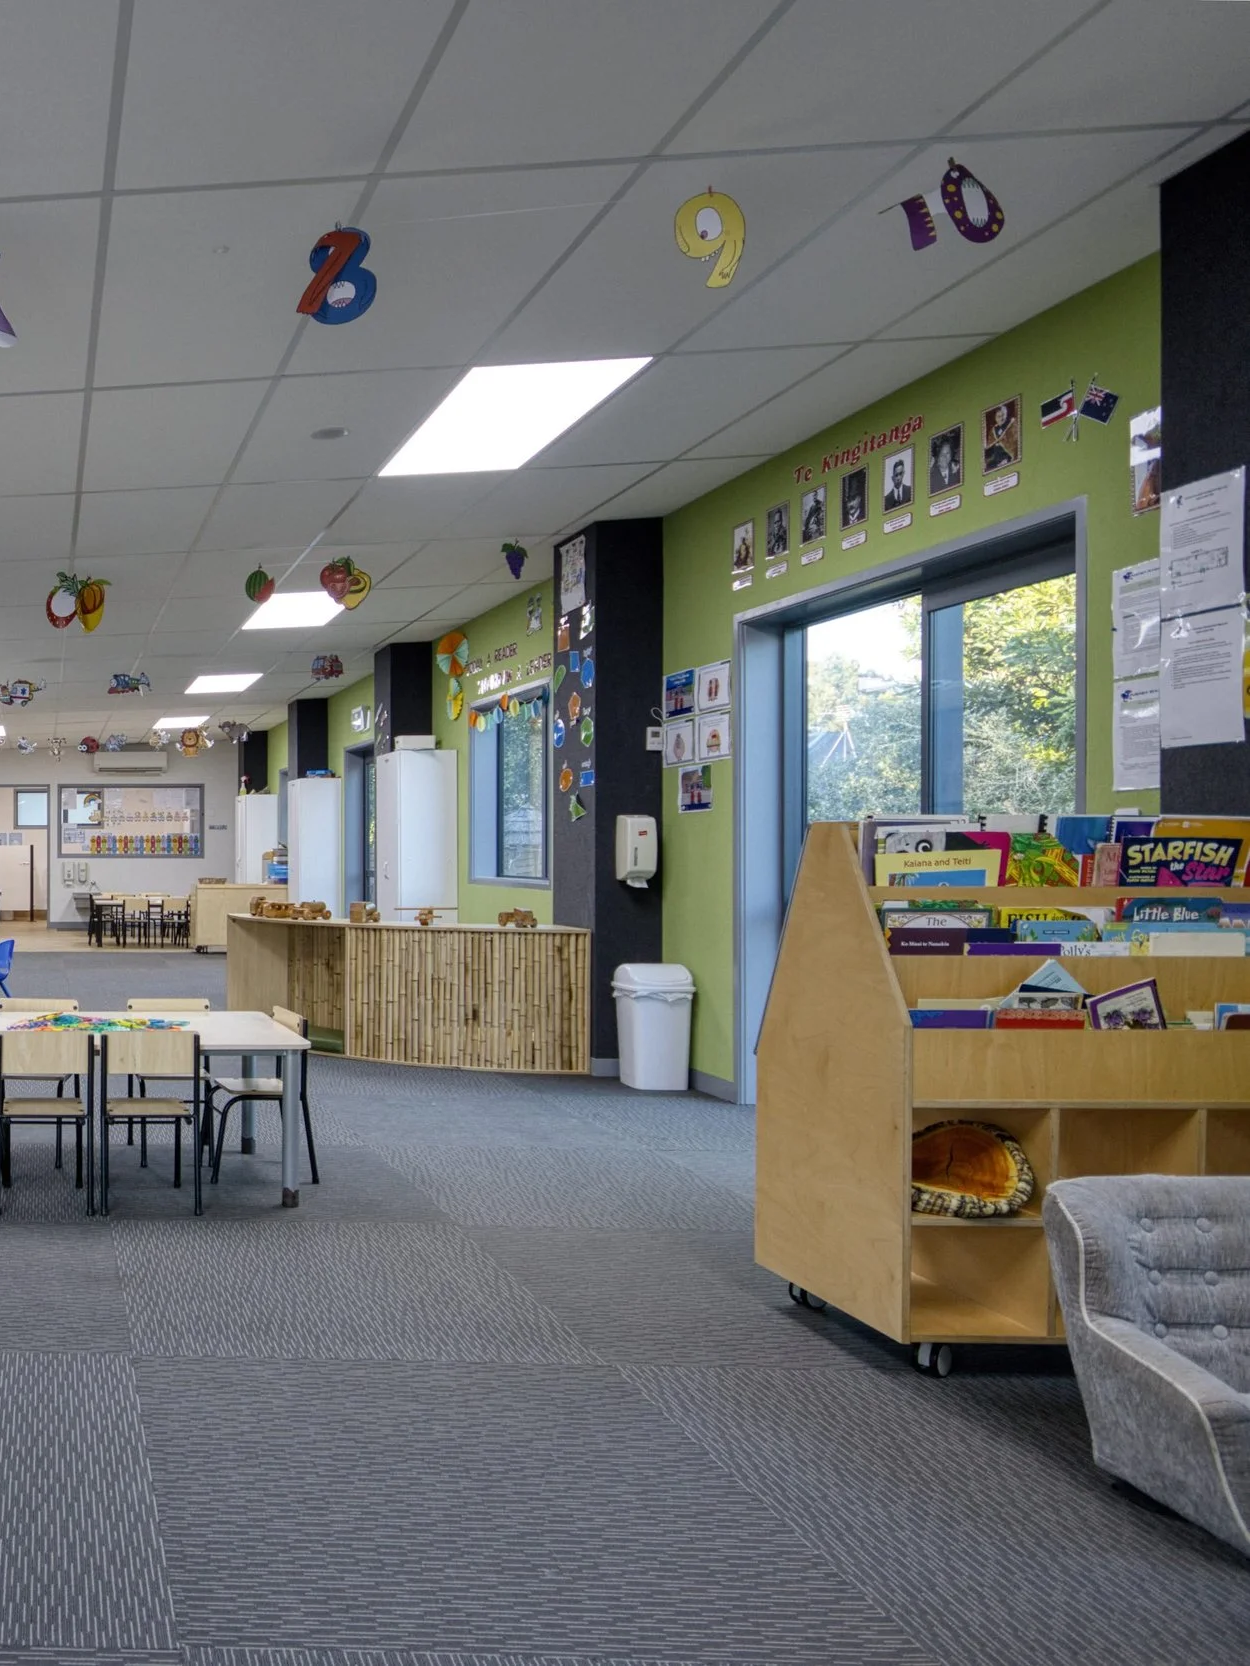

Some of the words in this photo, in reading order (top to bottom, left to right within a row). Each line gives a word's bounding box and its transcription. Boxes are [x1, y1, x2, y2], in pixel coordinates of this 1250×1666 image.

[674, 191, 746, 288] 9
[794, 466, 812, 484] Te
[821, 414, 925, 475] Kingitanga
[494, 642, 518, 662] READER
[934, 857, 950, 866] and
[1127, 840, 1235, 867] STARFISH
[1170, 861, 1185, 871] the
[1182, 860, 1231, 881] Star
[926, 916, 948, 926] The
[1132, 906, 1170, 922] Little
[1173, 906, 1199, 922] Blue
